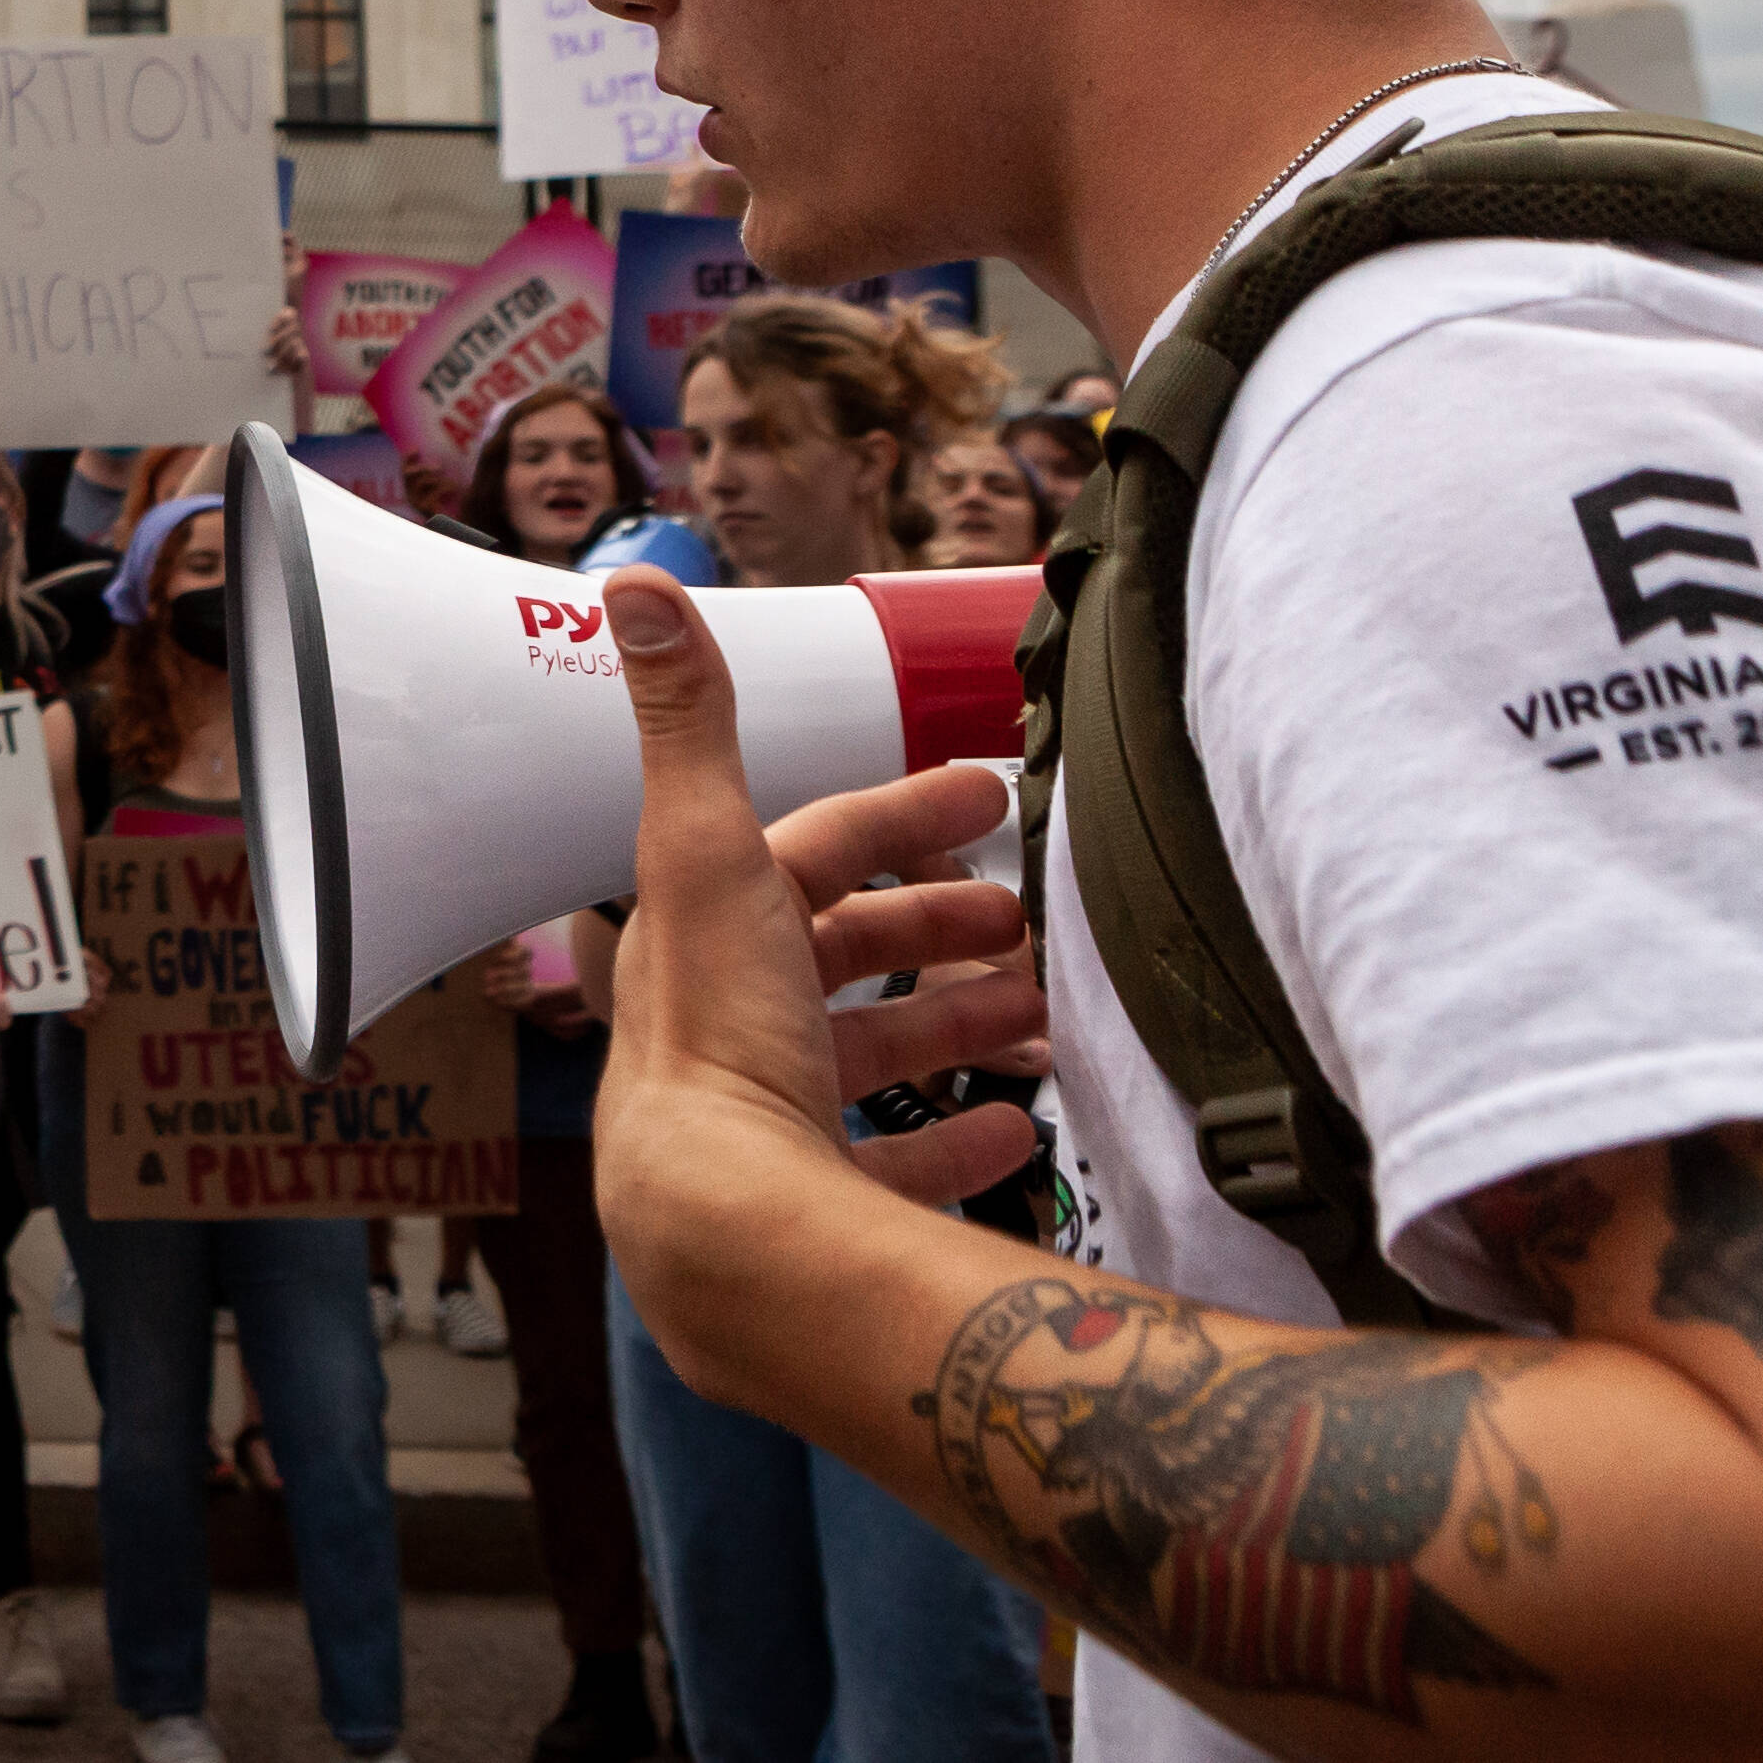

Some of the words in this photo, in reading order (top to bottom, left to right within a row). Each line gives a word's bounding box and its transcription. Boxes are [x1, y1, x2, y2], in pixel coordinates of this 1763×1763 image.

[419, 314, 507, 407] YOUTH
[493, 276, 556, 330] FOR
[1502, 653, 1763, 741] VIRGINIA
[1620, 718, 1723, 767] EST.
[140, 1027, 376, 1092] UTERS
[298, 1082, 432, 1144] FUCK
[185, 1136, 521, 1208] POLITICIAN
